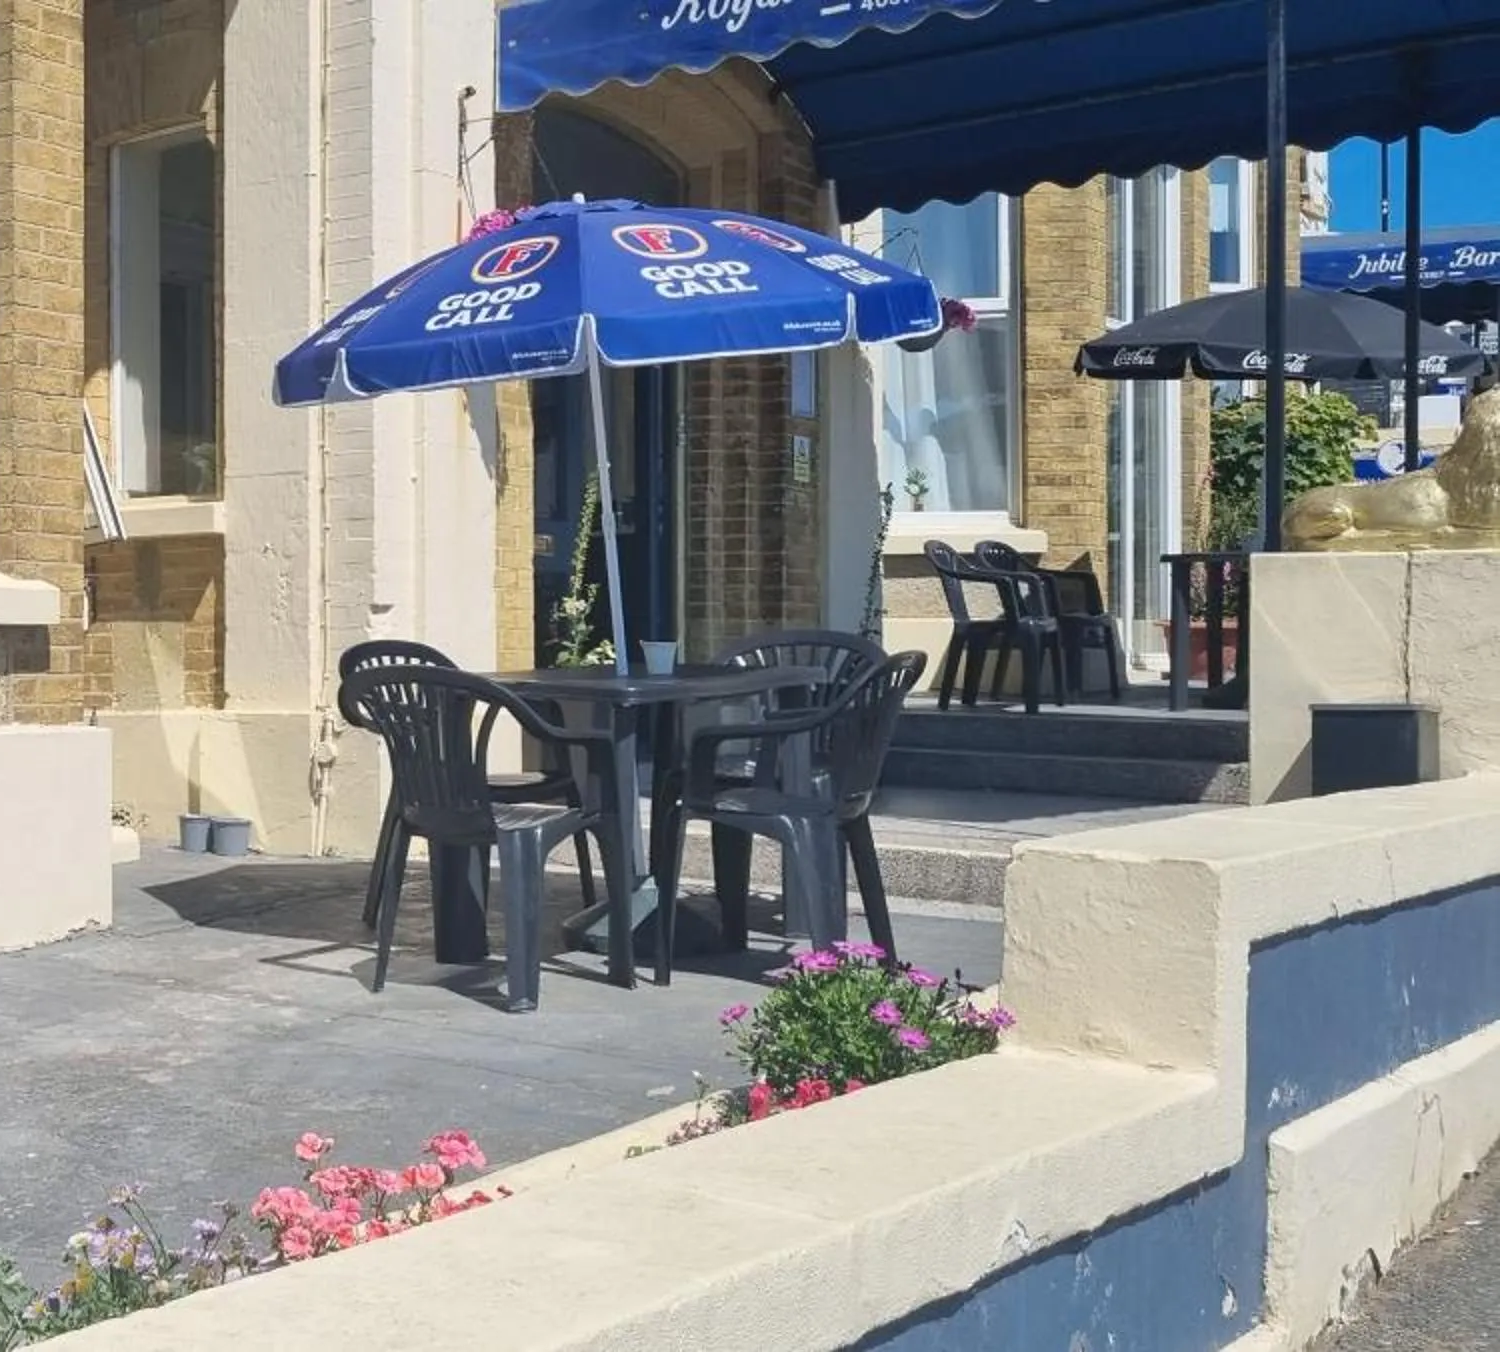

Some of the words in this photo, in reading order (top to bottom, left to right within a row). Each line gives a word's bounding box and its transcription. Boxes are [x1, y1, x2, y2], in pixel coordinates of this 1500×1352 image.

[1449, 245, 1500, 268] Bar
[640, 260, 751, 282] GOOD
[437, 282, 542, 312] GOOD
[655, 277, 760, 299] CALL
[424, 303, 514, 331] CALL
